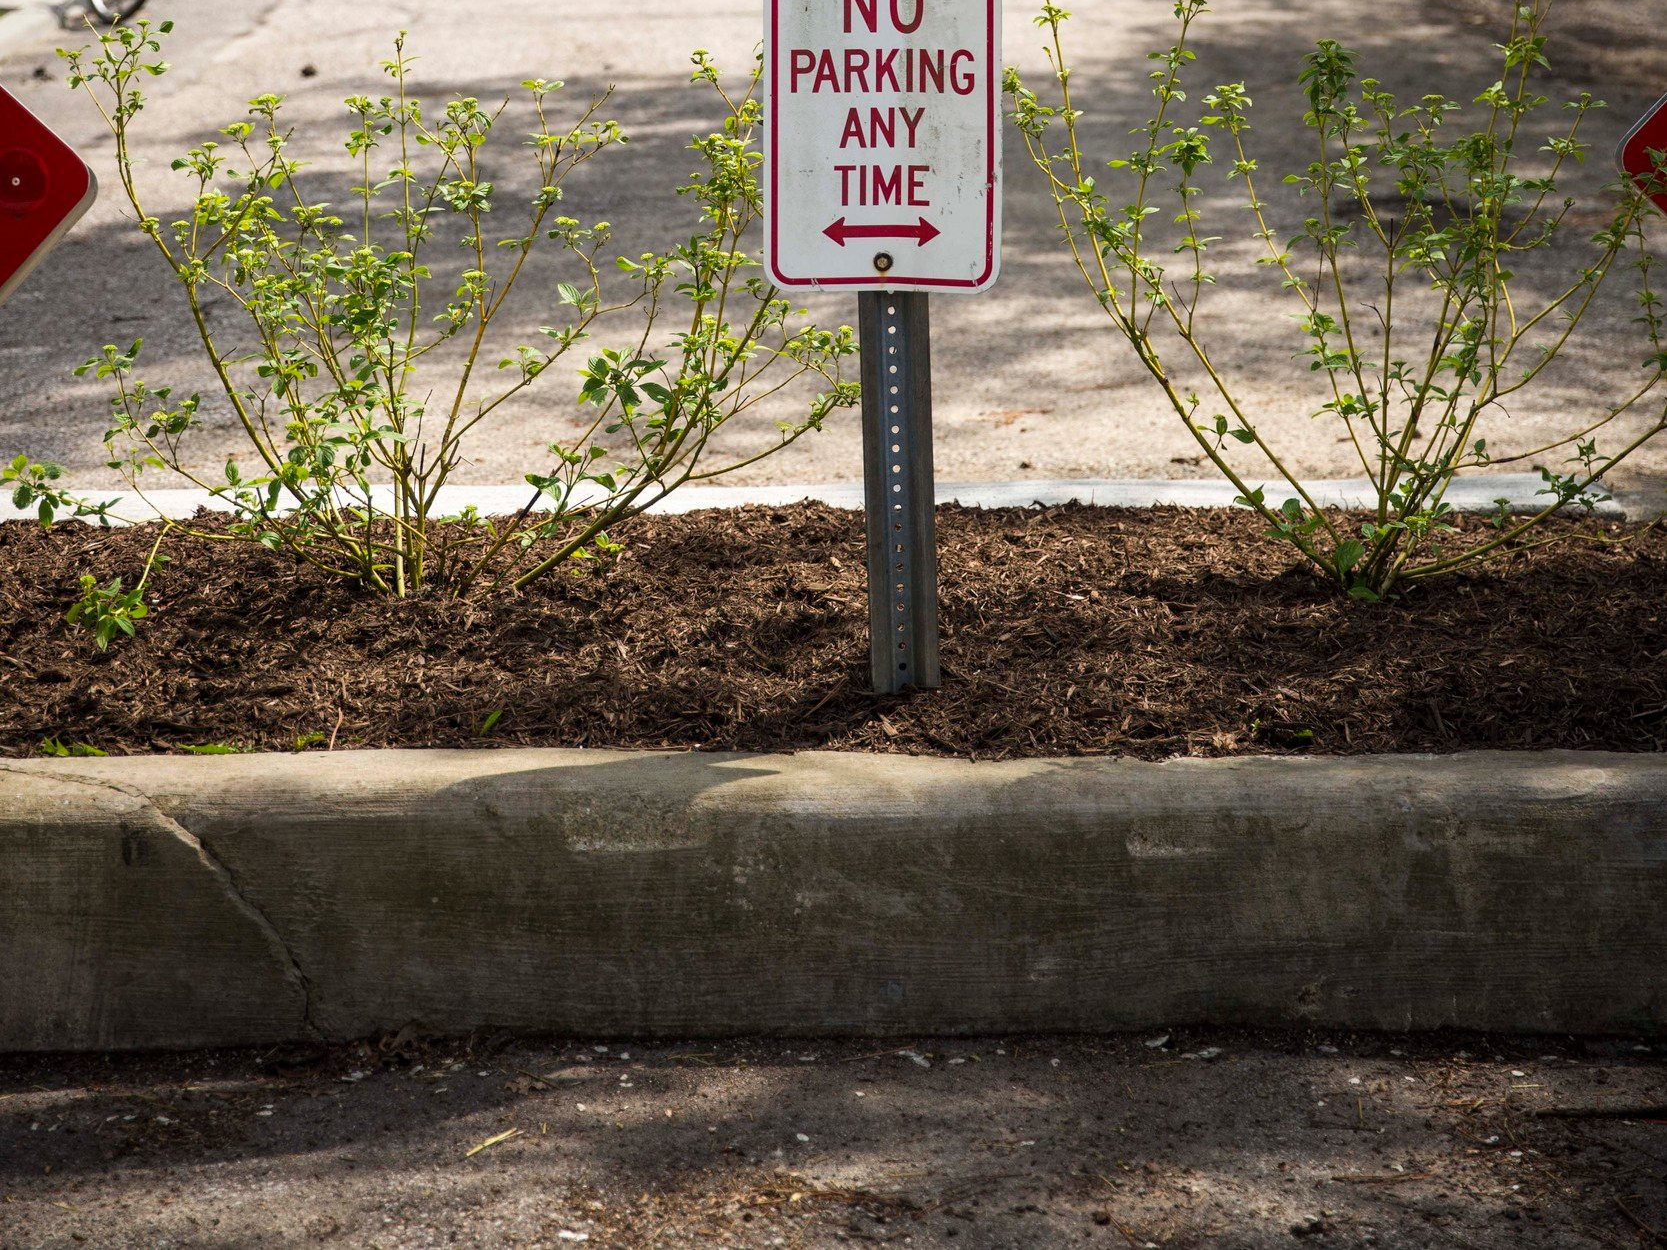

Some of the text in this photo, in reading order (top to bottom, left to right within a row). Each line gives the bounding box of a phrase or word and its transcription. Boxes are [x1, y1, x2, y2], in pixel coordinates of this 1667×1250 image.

[790, 49, 975, 96] PARKING
[840, 107, 925, 149] ANY
[834, 165, 930, 207] TIME
